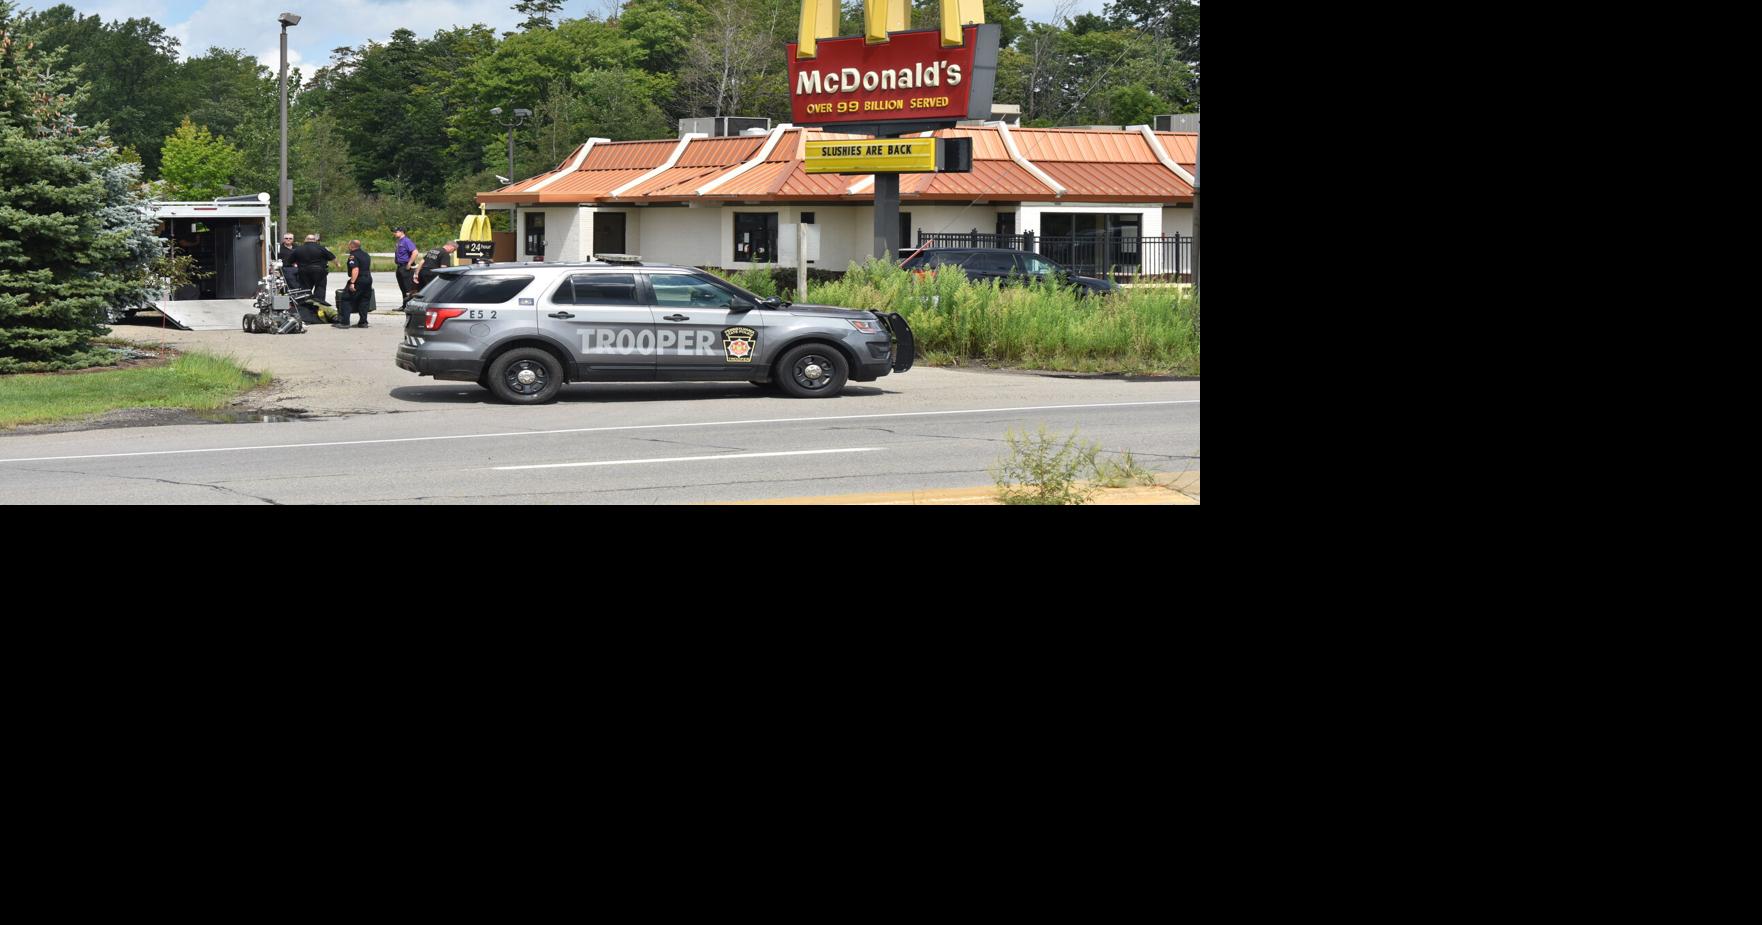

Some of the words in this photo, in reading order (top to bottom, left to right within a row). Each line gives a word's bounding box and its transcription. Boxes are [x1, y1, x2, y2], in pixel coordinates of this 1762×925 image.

[796, 60, 962, 95] McDonald's
[806, 102, 833, 114] OVER
[837, 101, 859, 112] 99
[864, 99, 904, 111] BILLION
[910, 96, 949, 109] SERVED
[821, 146, 861, 157] SLUSHIES
[866, 145, 882, 155] ARE
[888, 145, 912, 155] BACK
[470, 243, 481, 252] 24
[576, 328, 717, 356] TROOPER
